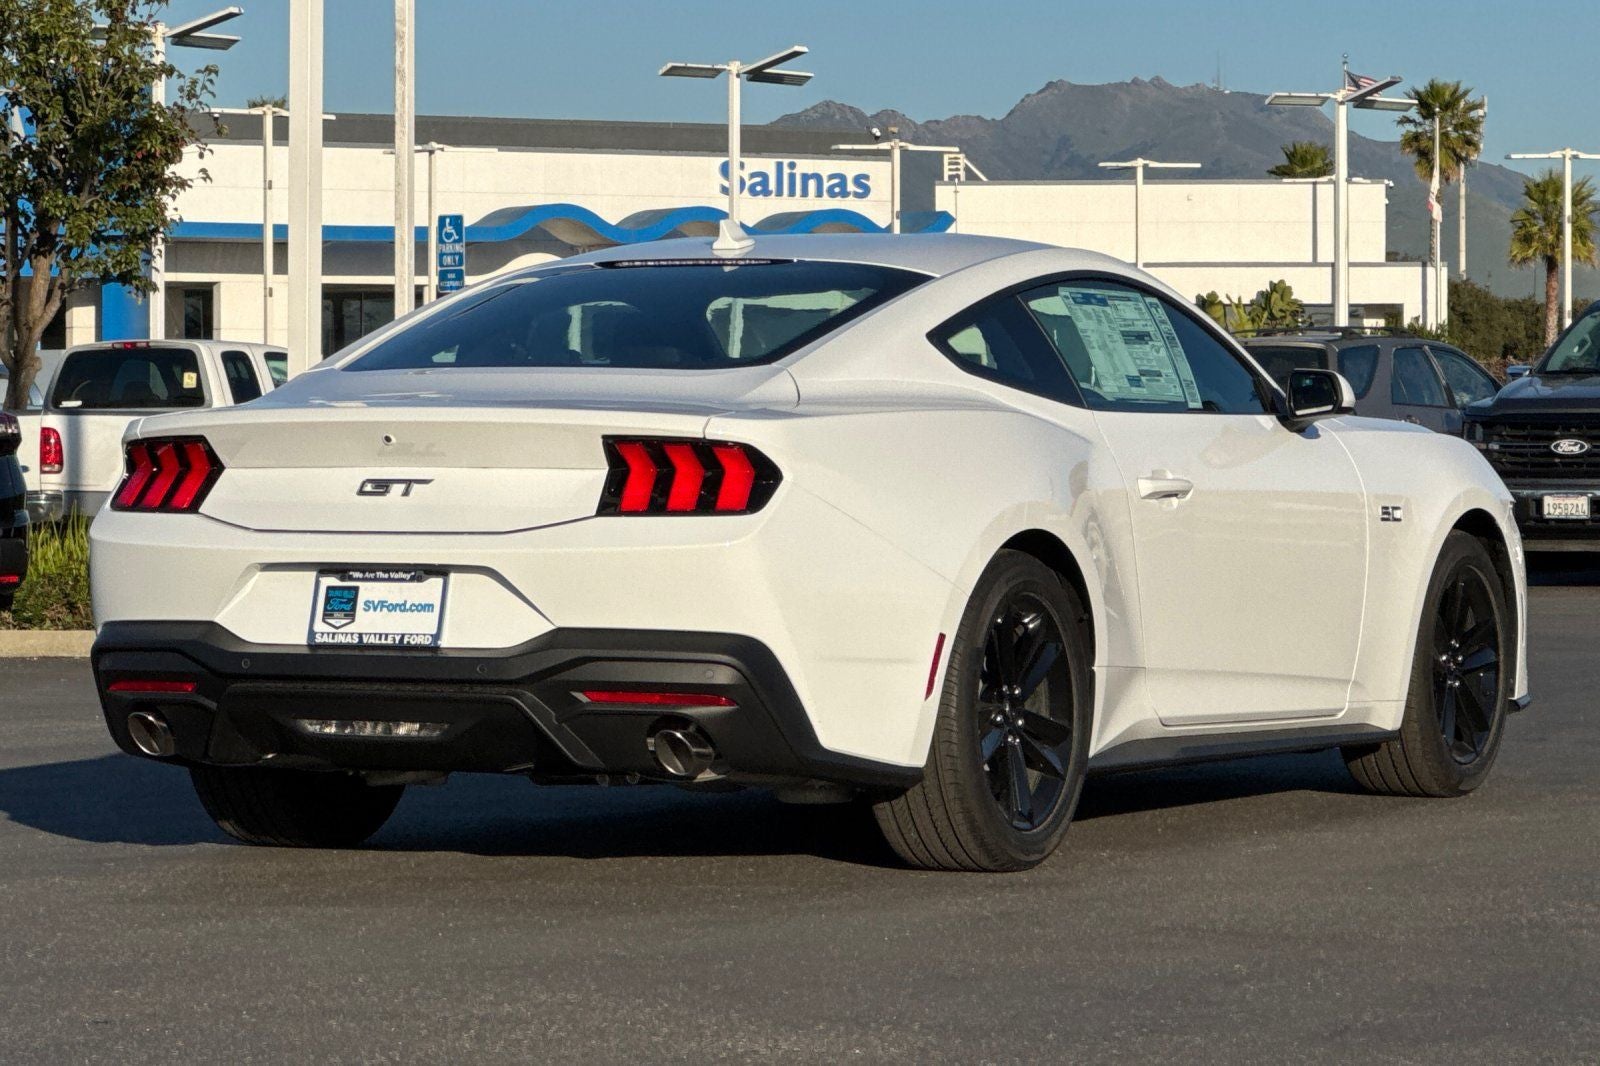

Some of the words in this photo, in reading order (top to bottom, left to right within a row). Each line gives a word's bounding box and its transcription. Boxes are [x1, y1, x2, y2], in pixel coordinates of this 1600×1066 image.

[719, 160, 871, 198] Salinas
[442, 255, 459, 265] ONLY
[1557, 441, 1580, 452] Ford
[356, 478, 435, 496] GT
[376, 571, 389, 579] The
[327, 598, 353, 610] Ford
[363, 600, 434, 612] SVFord.com
[315, 633, 359, 644] SALINAS
[362, 634, 402, 645] VALLEY
[403, 635, 432, 645] FORD
